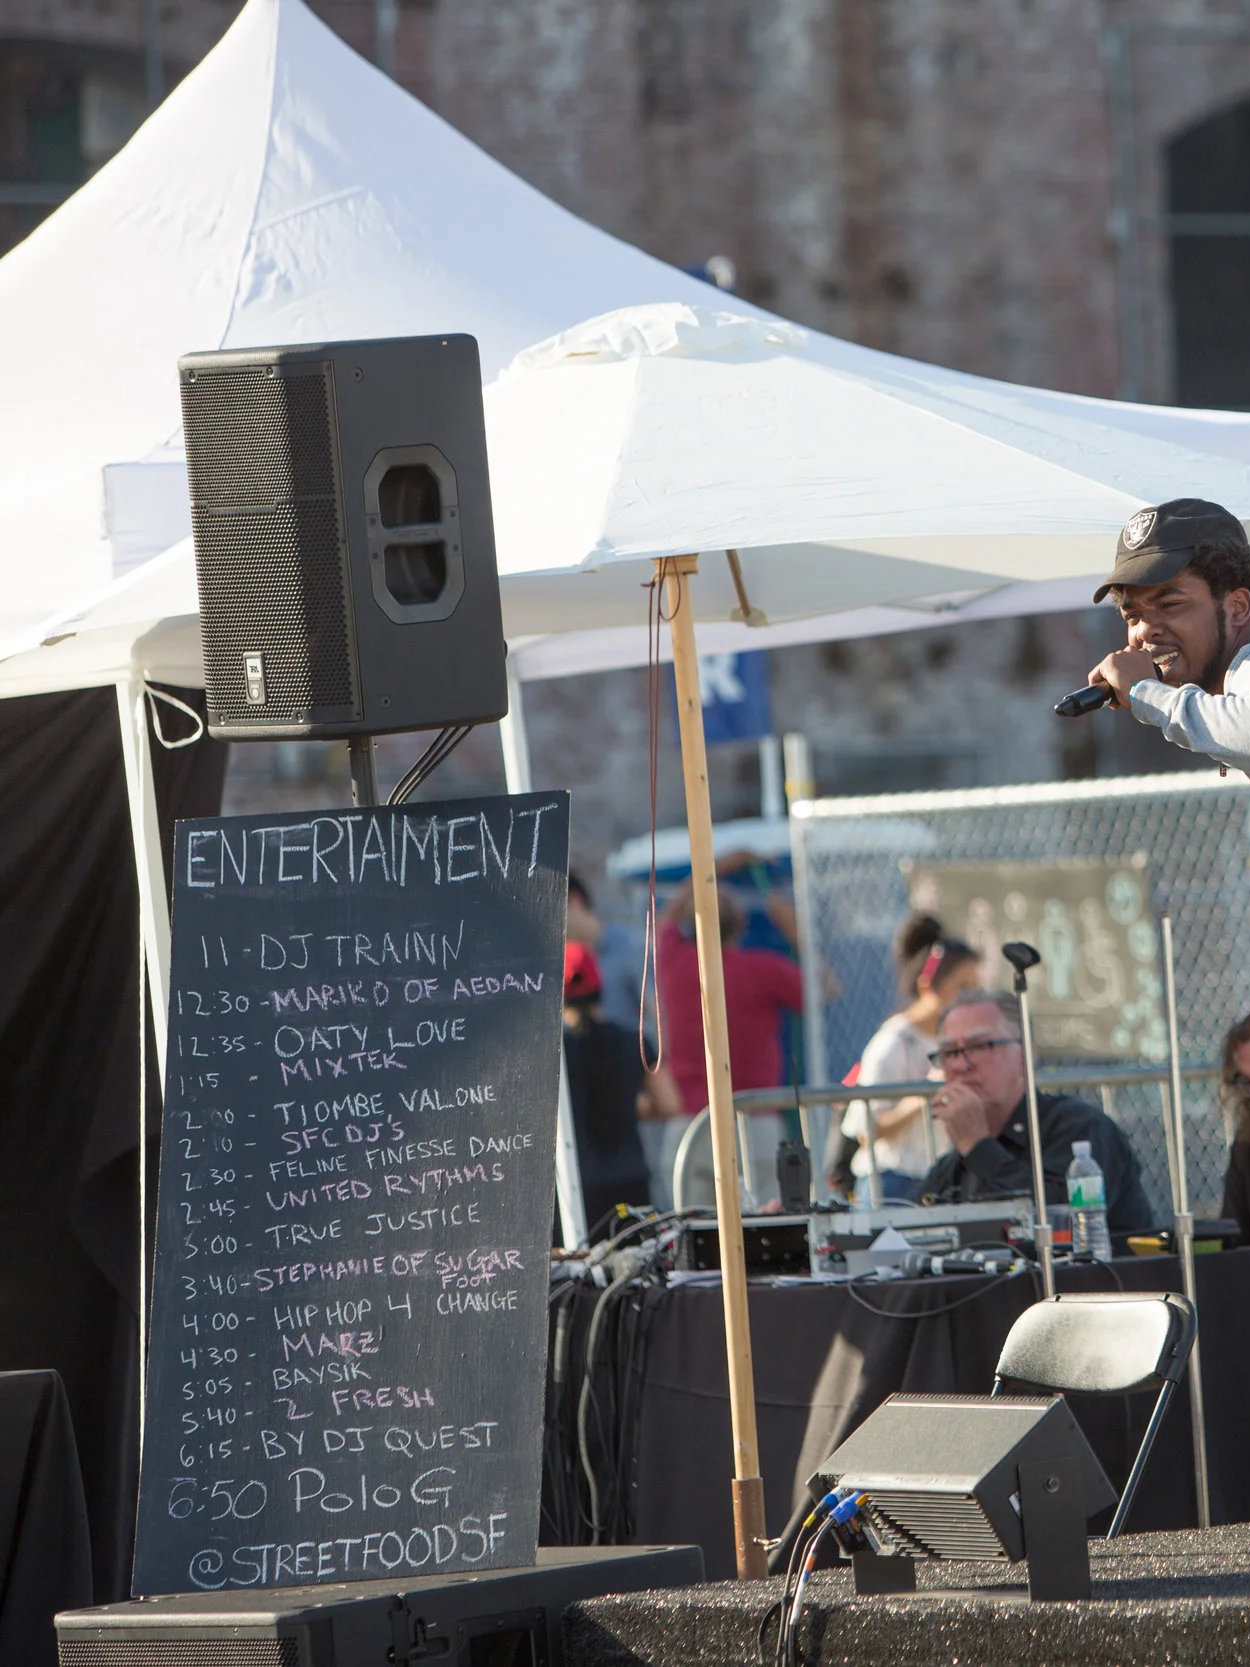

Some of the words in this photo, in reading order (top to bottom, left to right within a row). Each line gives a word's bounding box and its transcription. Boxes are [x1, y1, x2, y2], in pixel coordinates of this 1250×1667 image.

[187, 802, 558, 888] ENTERTAIMENT
[201, 935, 228, 968] 11
[260, 933, 313, 970] DJ
[325, 919, 464, 970] TRAINN
[177, 989, 250, 1016] 12:30
[404, 978, 440, 1002] OF
[177, 1034, 247, 1057] 12:35
[274, 1024, 369, 1058] OATY
[389, 1017, 466, 1050] LOVE
[280, 1050, 407, 1086] MIXTEK
[269, 1154, 348, 1182] FELINE
[366, 1139, 455, 1167] FINESSE
[469, 1133, 533, 1157] DANCE
[180, 1199, 235, 1225] 2:45
[266, 1180, 371, 1211] UNITED
[385, 1163, 504, 1197] RYTHMS
[265, 1219, 342, 1249] TRUE
[364, 1202, 481, 1236] JUSTICE
[182, 1275, 237, 1301] 3:40
[253, 1257, 385, 1292] STEPHANIE
[392, 1252, 428, 1276] OF
[435, 1249, 524, 1274] SUGAR
[182, 1311, 239, 1336] 4:00
[388, 1294, 412, 1320] 4
[437, 1289, 518, 1315] CHANGE
[181, 1346, 238, 1369] 4:30
[182, 1376, 233, 1400] 5:05
[273, 1362, 371, 1390] BAYSIK
[182, 1407, 237, 1434] 5:40
[332, 1387, 434, 1415] FRESH
[180, 1440, 233, 1468] 6:15
[261, 1429, 305, 1460] BY
[324, 1426, 372, 1453] DJ
[384, 1421, 499, 1457] QUEST
[168, 1477, 267, 1520] 6:50
